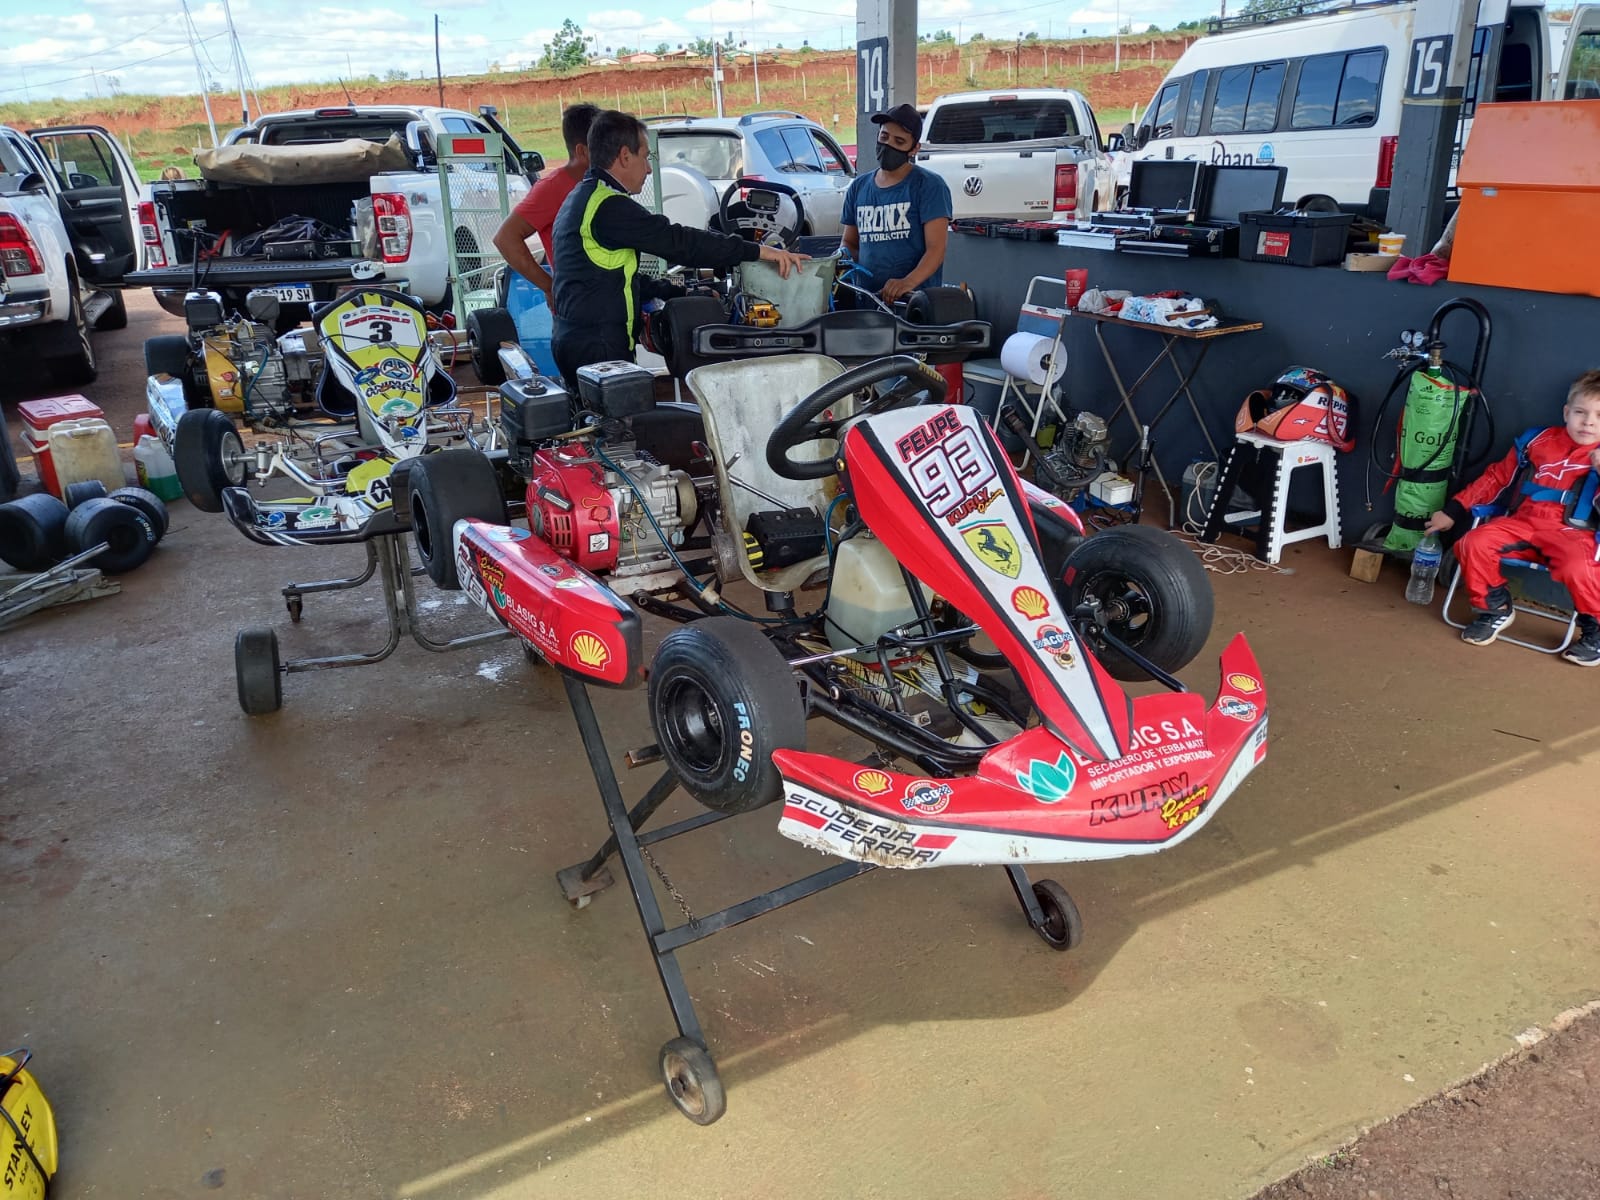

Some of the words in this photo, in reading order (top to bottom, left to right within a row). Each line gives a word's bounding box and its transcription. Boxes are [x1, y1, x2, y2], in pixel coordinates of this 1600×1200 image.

[861, 46, 884, 112] 14
[1413, 40, 1444, 95] 15
[857, 202, 911, 233] BRONX
[892, 230, 910, 240] CITY
[369, 321, 393, 343] 3
[895, 407, 961, 463] FELIPE
[908, 425, 998, 518] 93
[506, 594, 537, 628] BLASIG
[539, 620, 560, 643] S.A.
[1161, 717, 1204, 740] S.A.
[1141, 748, 1157, 760] DE
[1156, 742, 1186, 756] YERBA
[1089, 761, 1157, 791] IMPORTADOR
[1156, 757, 1164, 769] Y
[786, 793, 917, 844] SCUDERIA
[825, 823, 942, 863] FERRARI
